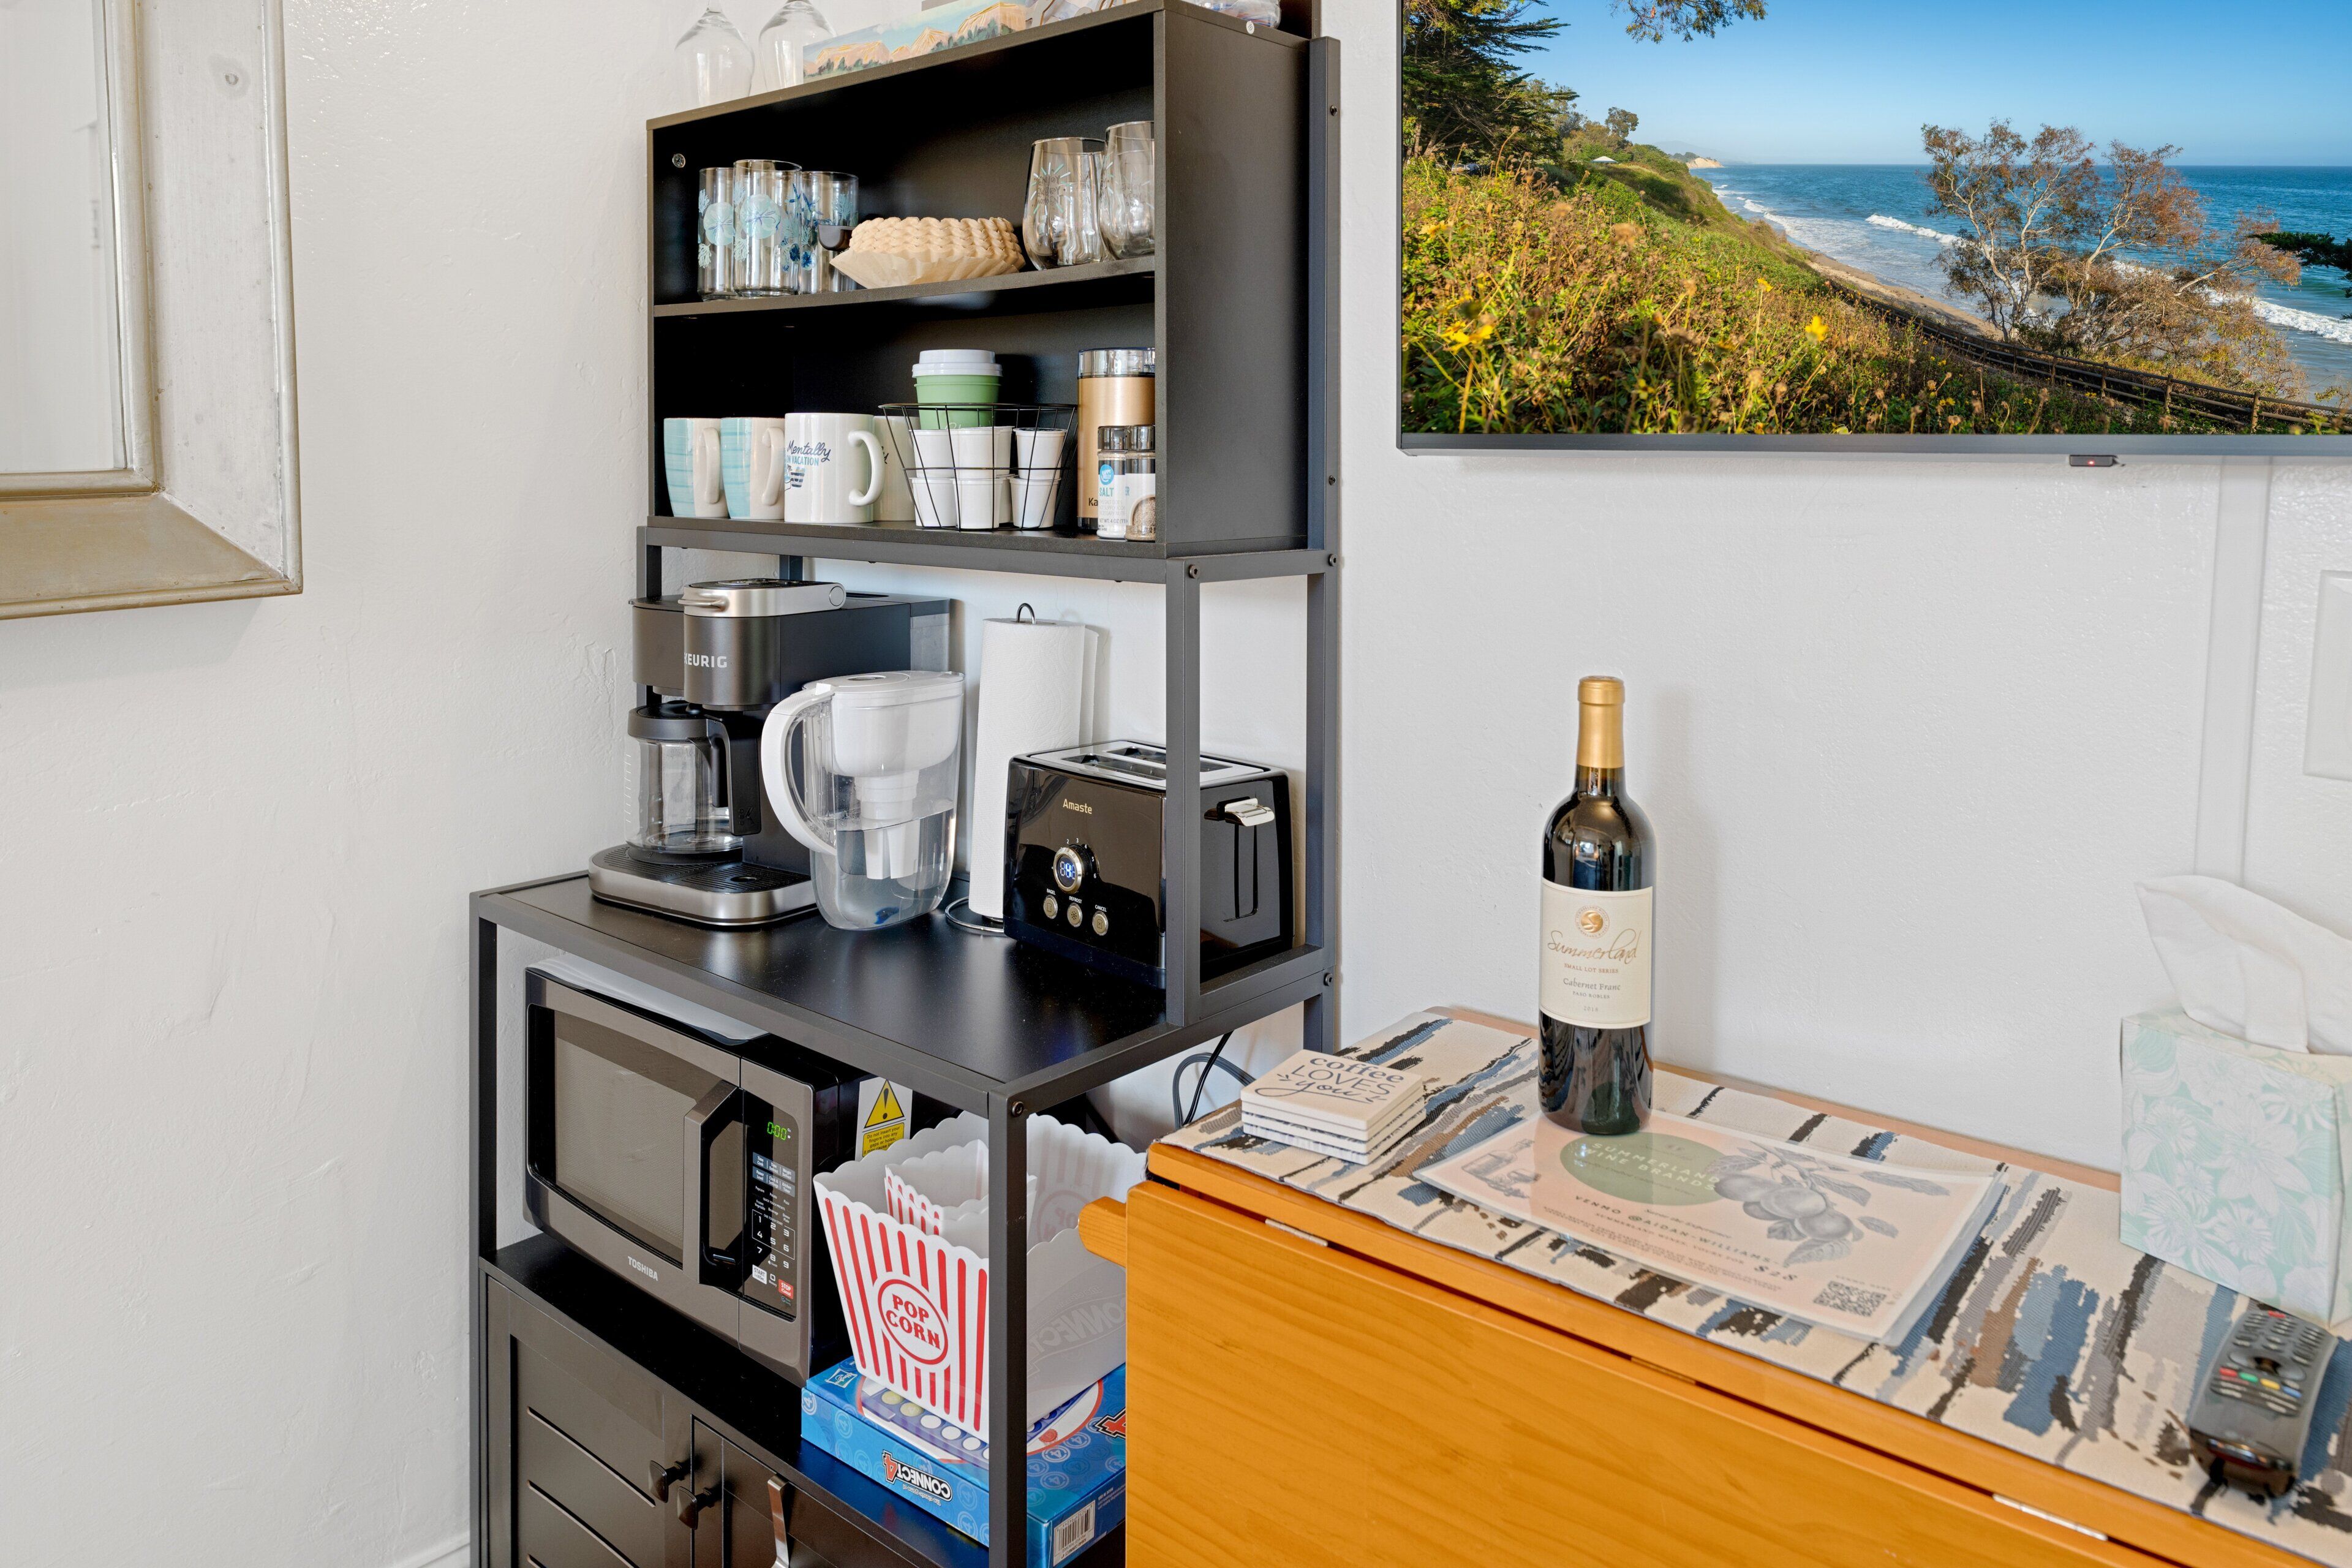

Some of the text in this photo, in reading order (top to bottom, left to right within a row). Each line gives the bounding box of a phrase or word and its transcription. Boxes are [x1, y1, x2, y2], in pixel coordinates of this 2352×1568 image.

[787, 440, 831, 462] Mentally
[792, 456, 819, 466] VACATION
[1099, 487, 1114, 497] SALT
[684, 652, 727, 668] KEURIG
[1063, 798, 1093, 815] Amaste
[1069, 895, 1083, 904] DEFROST
[1548, 928, 1642, 965] Summerland
[1564, 963, 1582, 971] SMALL
[1563, 977, 1597, 990] Cabernet
[1291, 1065, 1396, 1095] LOVES
[1310, 1058, 1404, 1083] coffee
[1255, 1080, 1365, 1099] you
[767, 1121, 787, 1140] 0:00
[1591, 1142, 1721, 1183] SUMMERLAND
[1638, 1164, 1716, 1191] BRANDS
[770, 1221, 776, 1231] 2
[783, 1228, 790, 1237] 3
[1575, 1195, 1621, 1215] VENMO
[1628, 1215, 1790, 1268] @AIDAN-WILLIAMS-
[770, 1237, 776, 1245] 5
[783, 1243, 790, 1252] 6
[627, 1256, 658, 1281] TOSHIBA
[770, 1253, 776, 1262] 8
[783, 1261, 789, 1269] 9
[754, 1267, 765, 1277] START
[781, 1282, 791, 1291] STOP
[892, 1294, 929, 1324] POP
[886, 1310, 941, 1350] CORN
[884, 1453, 951, 1499] CONNECT 4
